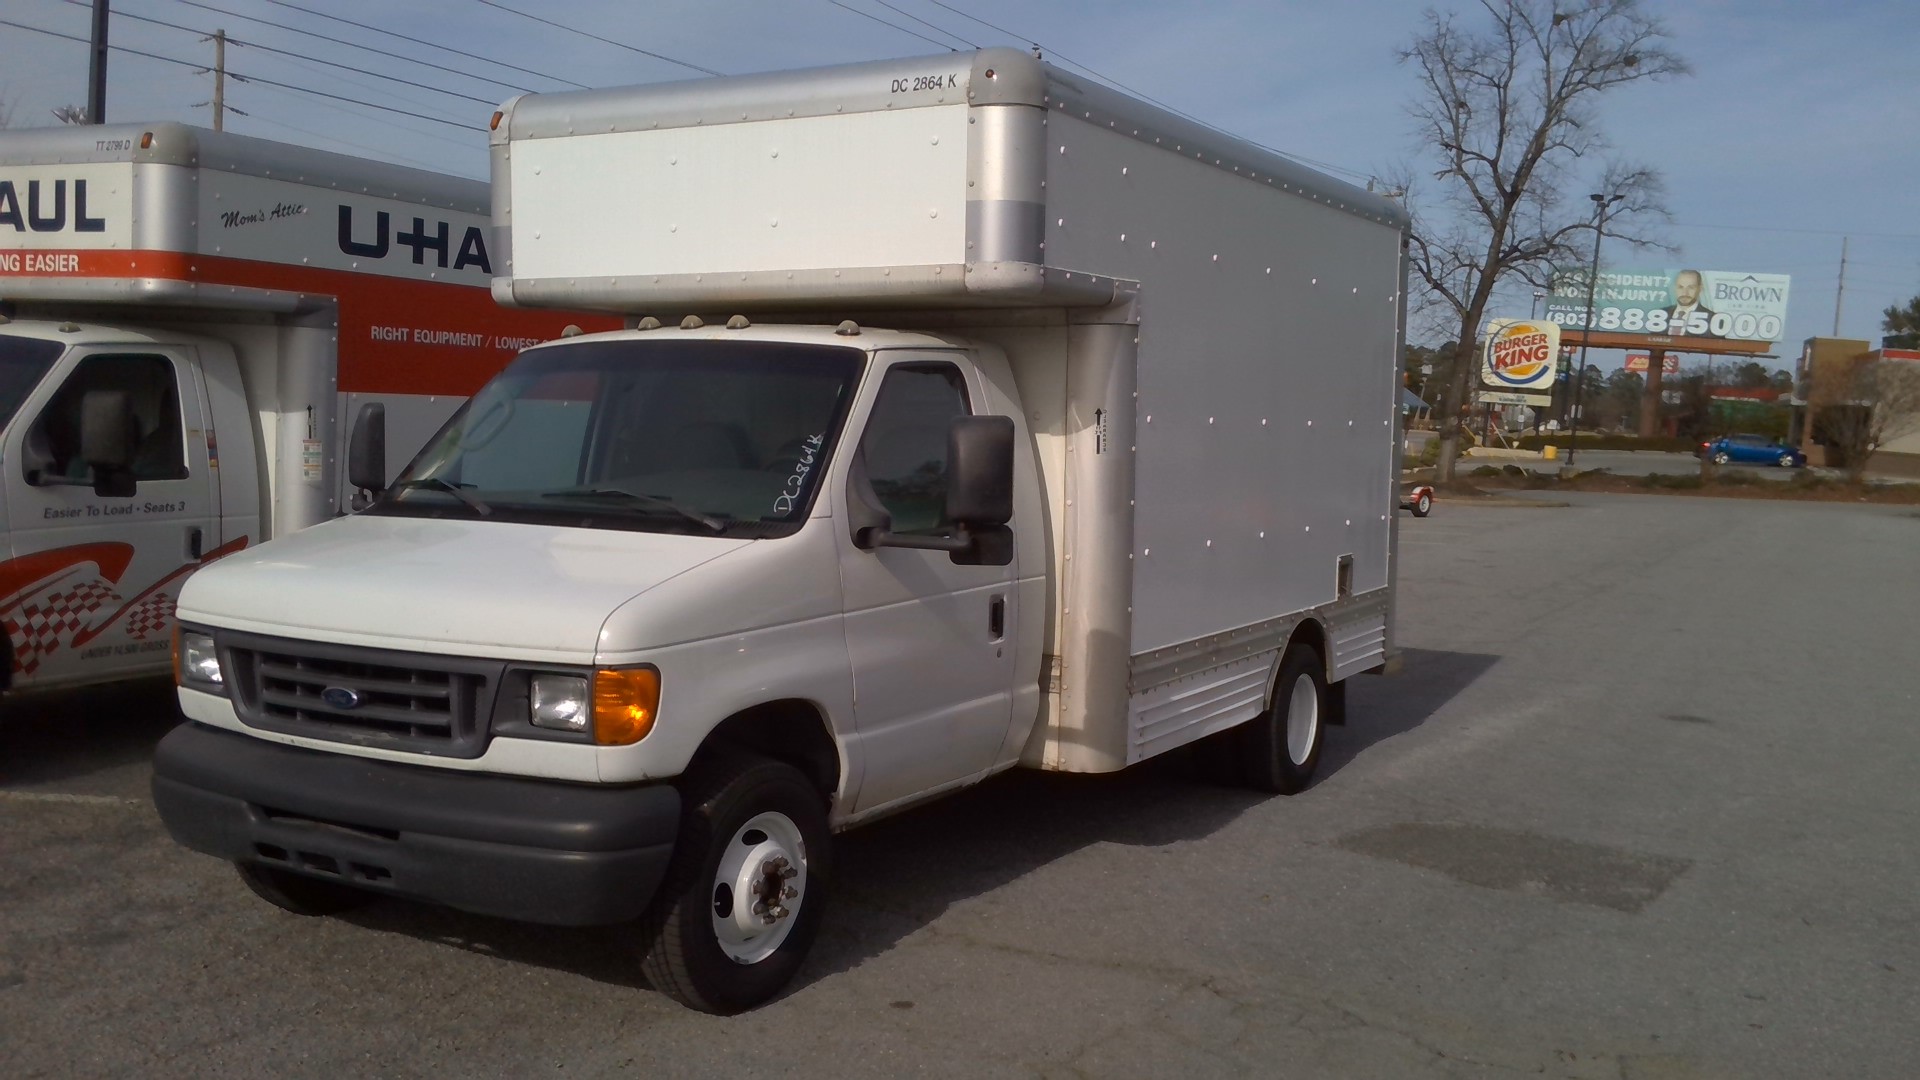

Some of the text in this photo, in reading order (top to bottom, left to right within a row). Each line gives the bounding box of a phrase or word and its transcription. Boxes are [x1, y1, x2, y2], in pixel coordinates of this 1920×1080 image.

[891, 73, 958, 94] DC 2864 K
[124, 139, 131, 150] D
[220, 202, 303, 228] Mom's Attic
[25, 254, 79, 272] EASIER
[1714, 282, 1784, 303] BROWN
[1548, 304, 1573, 312] CALL
[1598, 306, 1782, 339] 888-5000
[370, 326, 409, 342] RIGHT
[413, 329, 483, 347] EQUIPMENT
[495, 336, 539, 350] LOWEST
[1494, 333, 1548, 354] BURGER
[1495, 344, 1549, 371] KING
[43, 500, 186, 519] Easier To Load Seats 3
